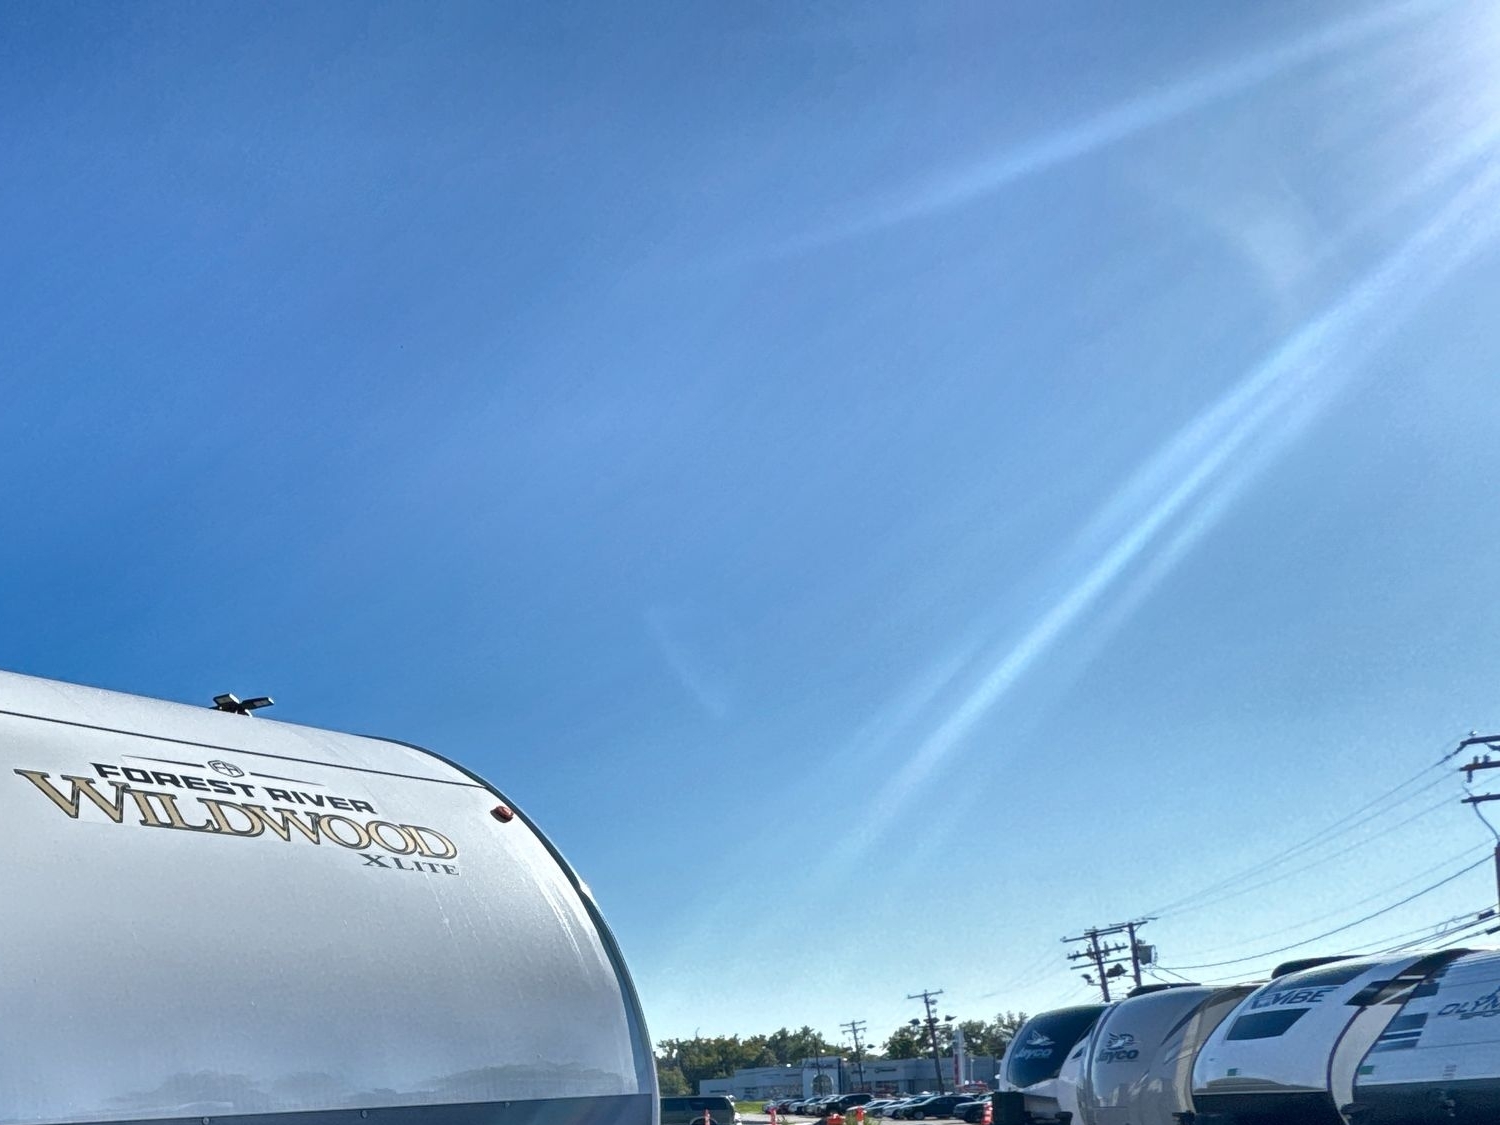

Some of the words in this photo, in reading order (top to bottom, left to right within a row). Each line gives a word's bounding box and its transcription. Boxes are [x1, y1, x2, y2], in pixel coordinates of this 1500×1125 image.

[13, 768, 458, 860] WILDWOOD
[90, 762, 256, 798] FOREST
[261, 786, 378, 814] RIVER
